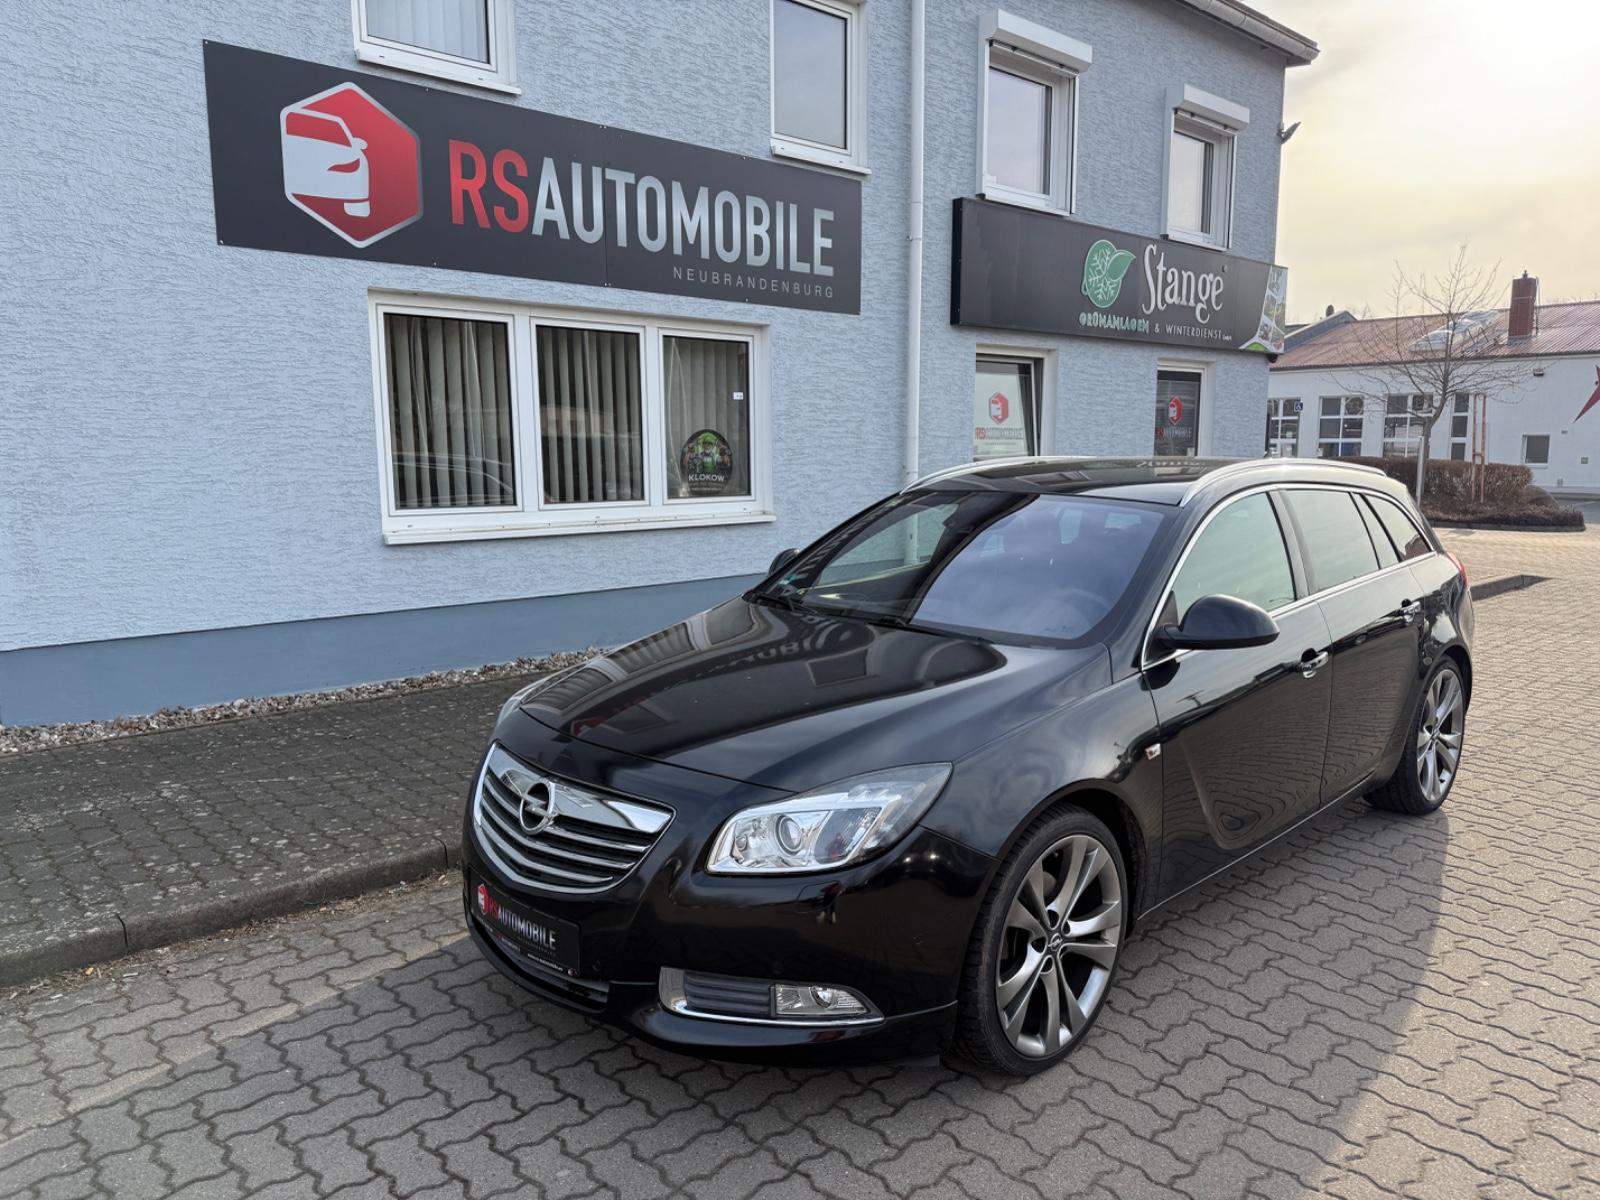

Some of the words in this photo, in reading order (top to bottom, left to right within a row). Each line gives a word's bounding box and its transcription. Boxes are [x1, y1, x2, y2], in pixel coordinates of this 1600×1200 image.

[672, 266, 834, 298] NEUBRANDENBURG
[1141, 243, 1224, 324] Stange
[1154, 323, 1160, 334] &
[1165, 323, 1222, 340] WINTERDIENST
[688, 474, 725, 482] KLOKOW
